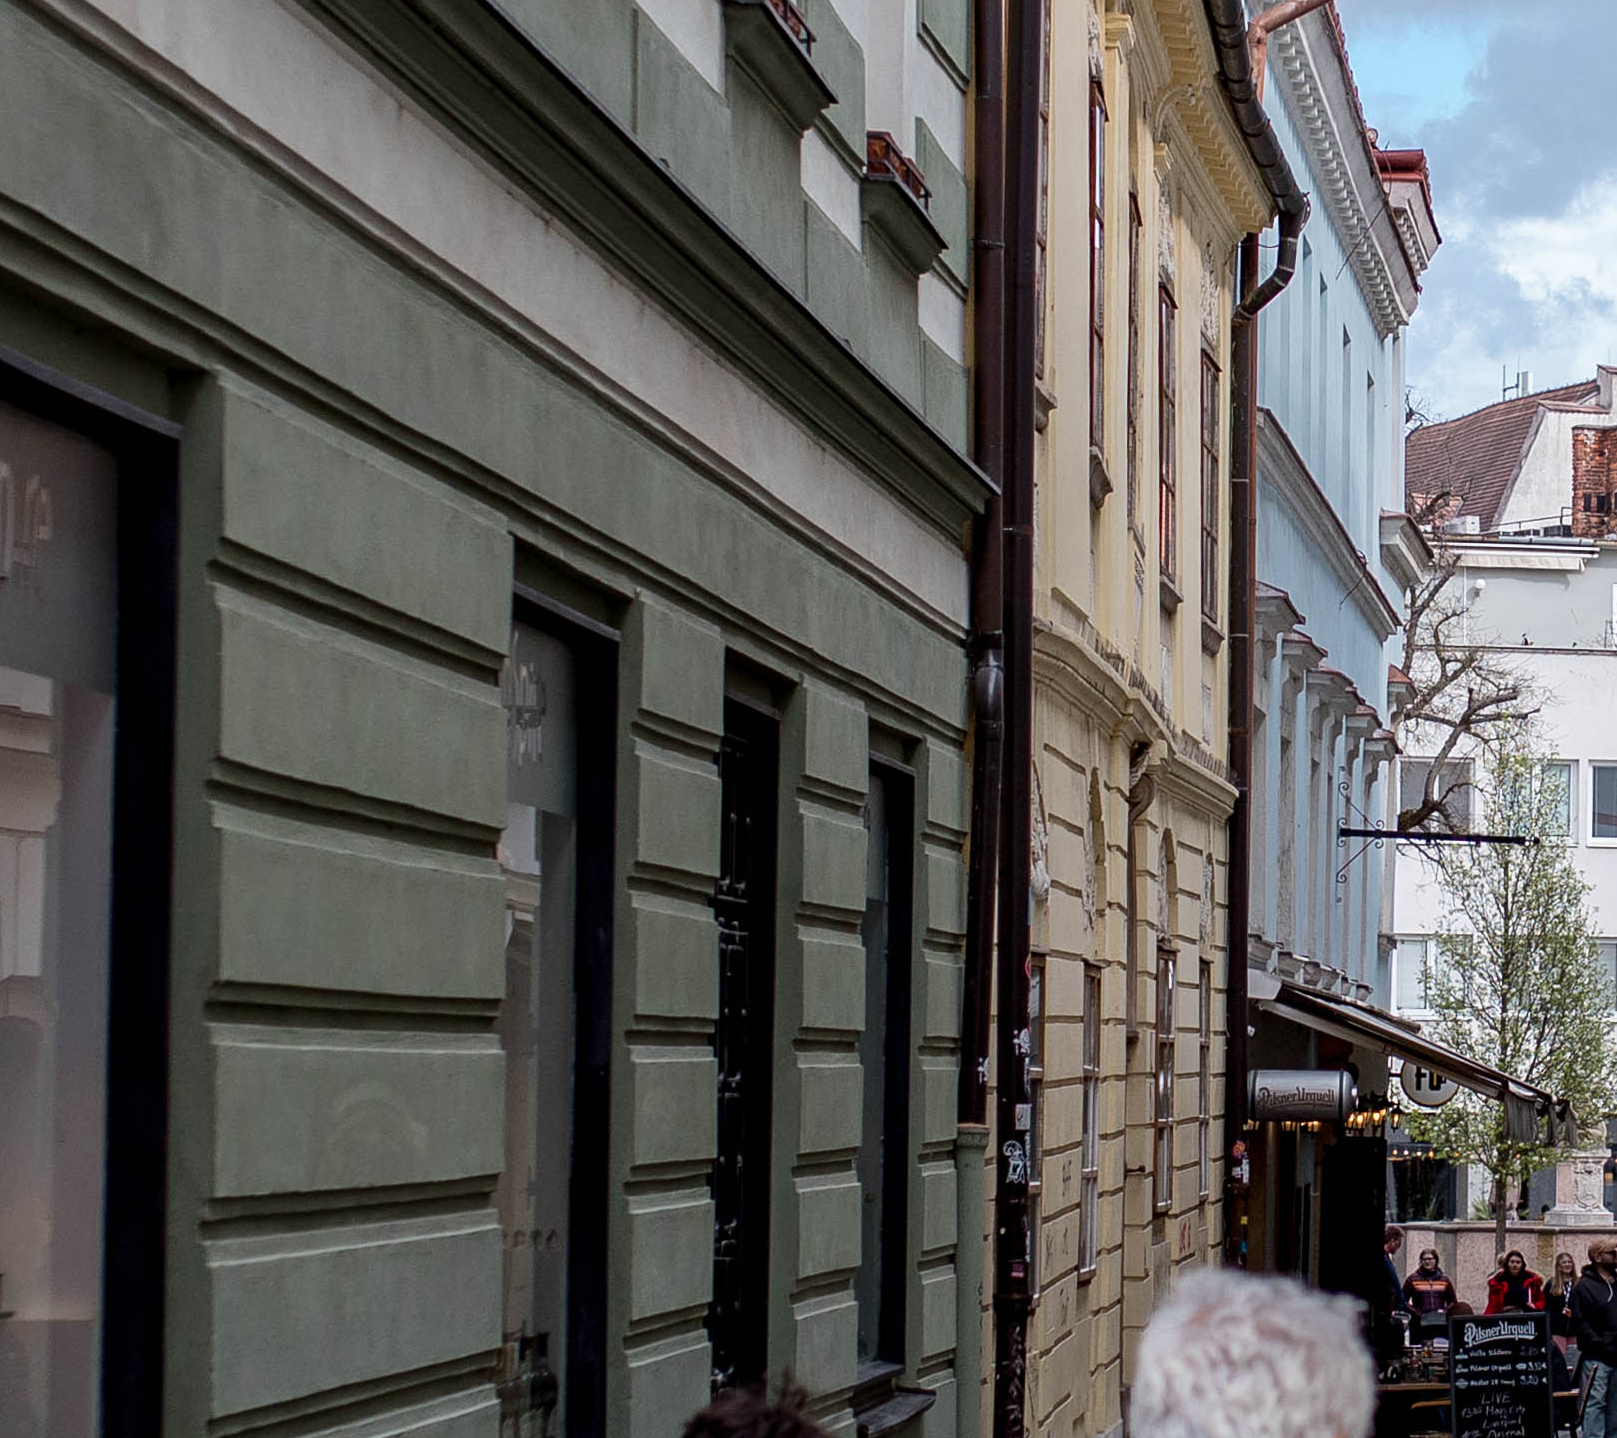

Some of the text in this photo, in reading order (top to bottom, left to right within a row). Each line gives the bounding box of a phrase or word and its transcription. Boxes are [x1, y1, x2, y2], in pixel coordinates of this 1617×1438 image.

[1257, 1086, 1335, 1112] Pilsner Urquell
[1464, 1320, 1535, 1348] Pilsner Urquell
[1481, 1391, 1512, 1405] LIVE
